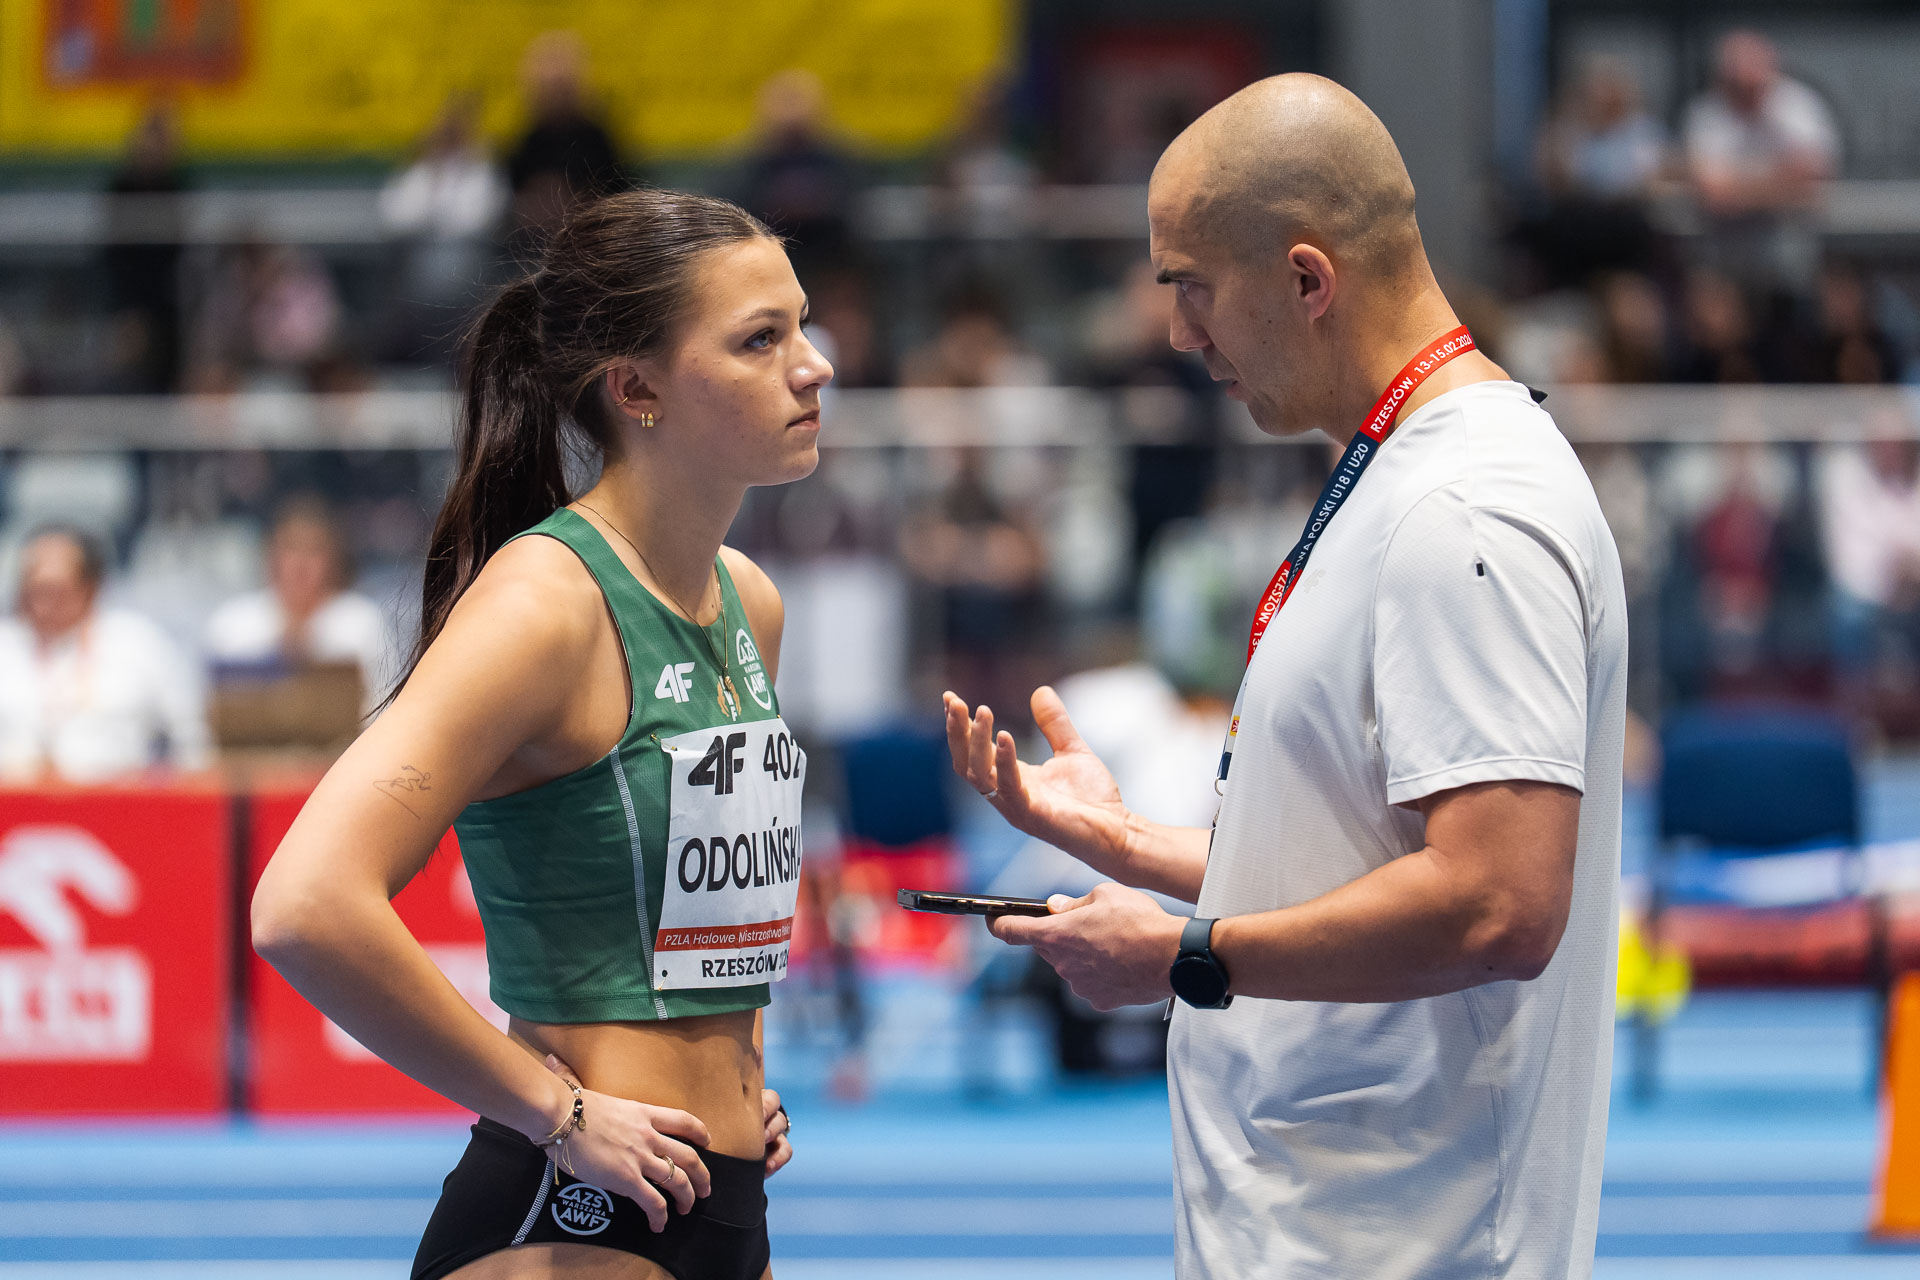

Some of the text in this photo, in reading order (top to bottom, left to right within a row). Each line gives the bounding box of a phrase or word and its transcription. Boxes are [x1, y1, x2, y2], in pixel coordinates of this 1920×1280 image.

[1370, 376, 1418, 433] RZESZÓW,
[1348, 443, 1369, 468] U20
[1343, 467, 1355, 475] i
[1330, 475, 1351, 499] U18
[1308, 500, 1337, 539] POLSKI
[654, 662, 695, 703] 4F
[688, 732, 746, 795] 4F
[664, 934, 690, 946] PZLA
[693, 932, 736, 945] Halowe
[701, 950, 778, 978] RZESZÓW
[562, 1199, 606, 1217] WARSZAWA
[565, 1189, 604, 1208] AZS
[559, 1207, 604, 1228] AWF
